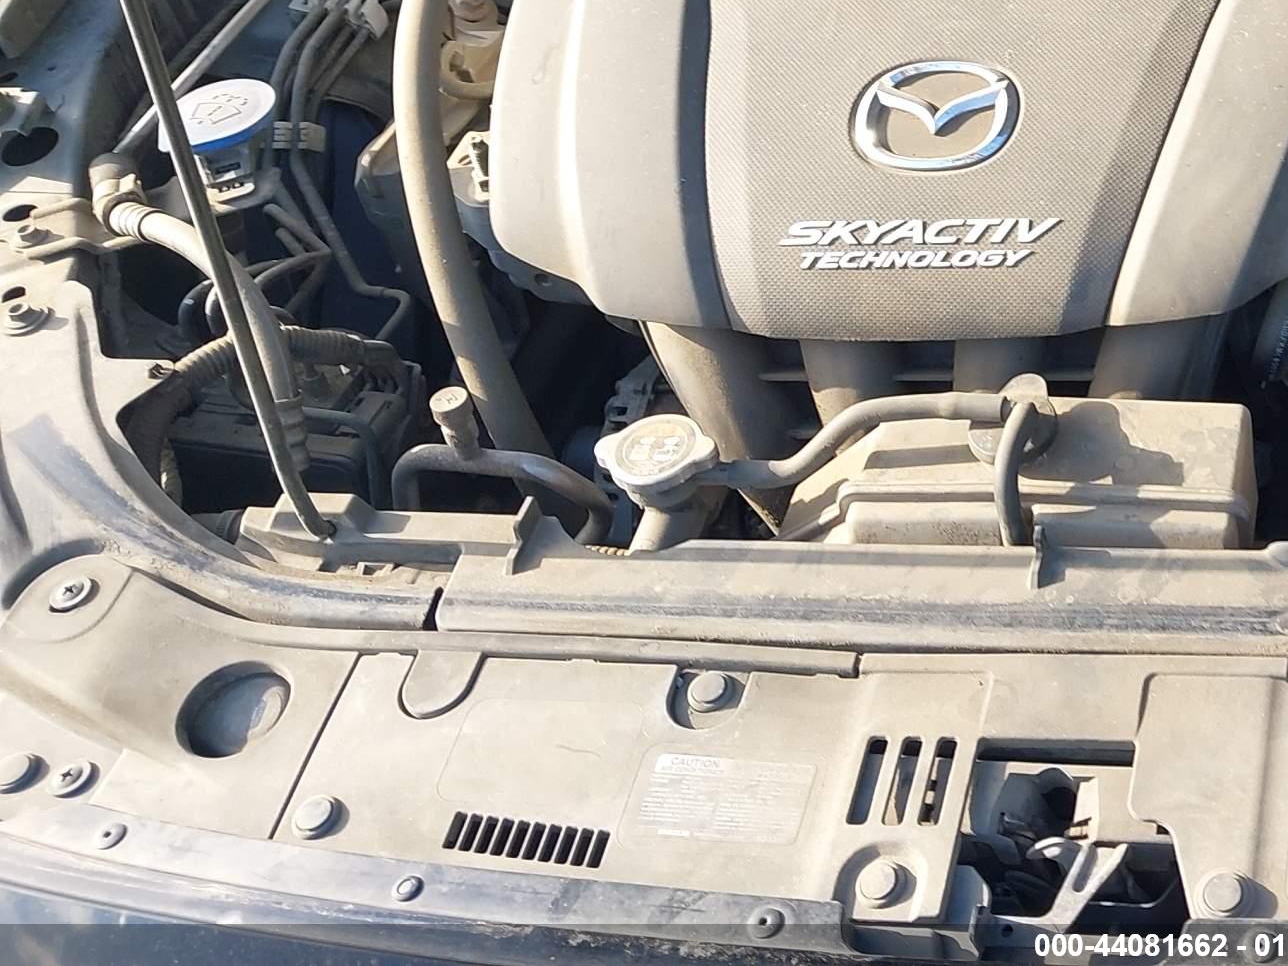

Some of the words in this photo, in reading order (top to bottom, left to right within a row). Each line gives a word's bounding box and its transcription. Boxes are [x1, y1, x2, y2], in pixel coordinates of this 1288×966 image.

[778, 217, 1064, 247] SKYACTIV
[799, 248, 1035, 270] TECHNOLOGY
[671, 756, 721, 769] CAUTION
